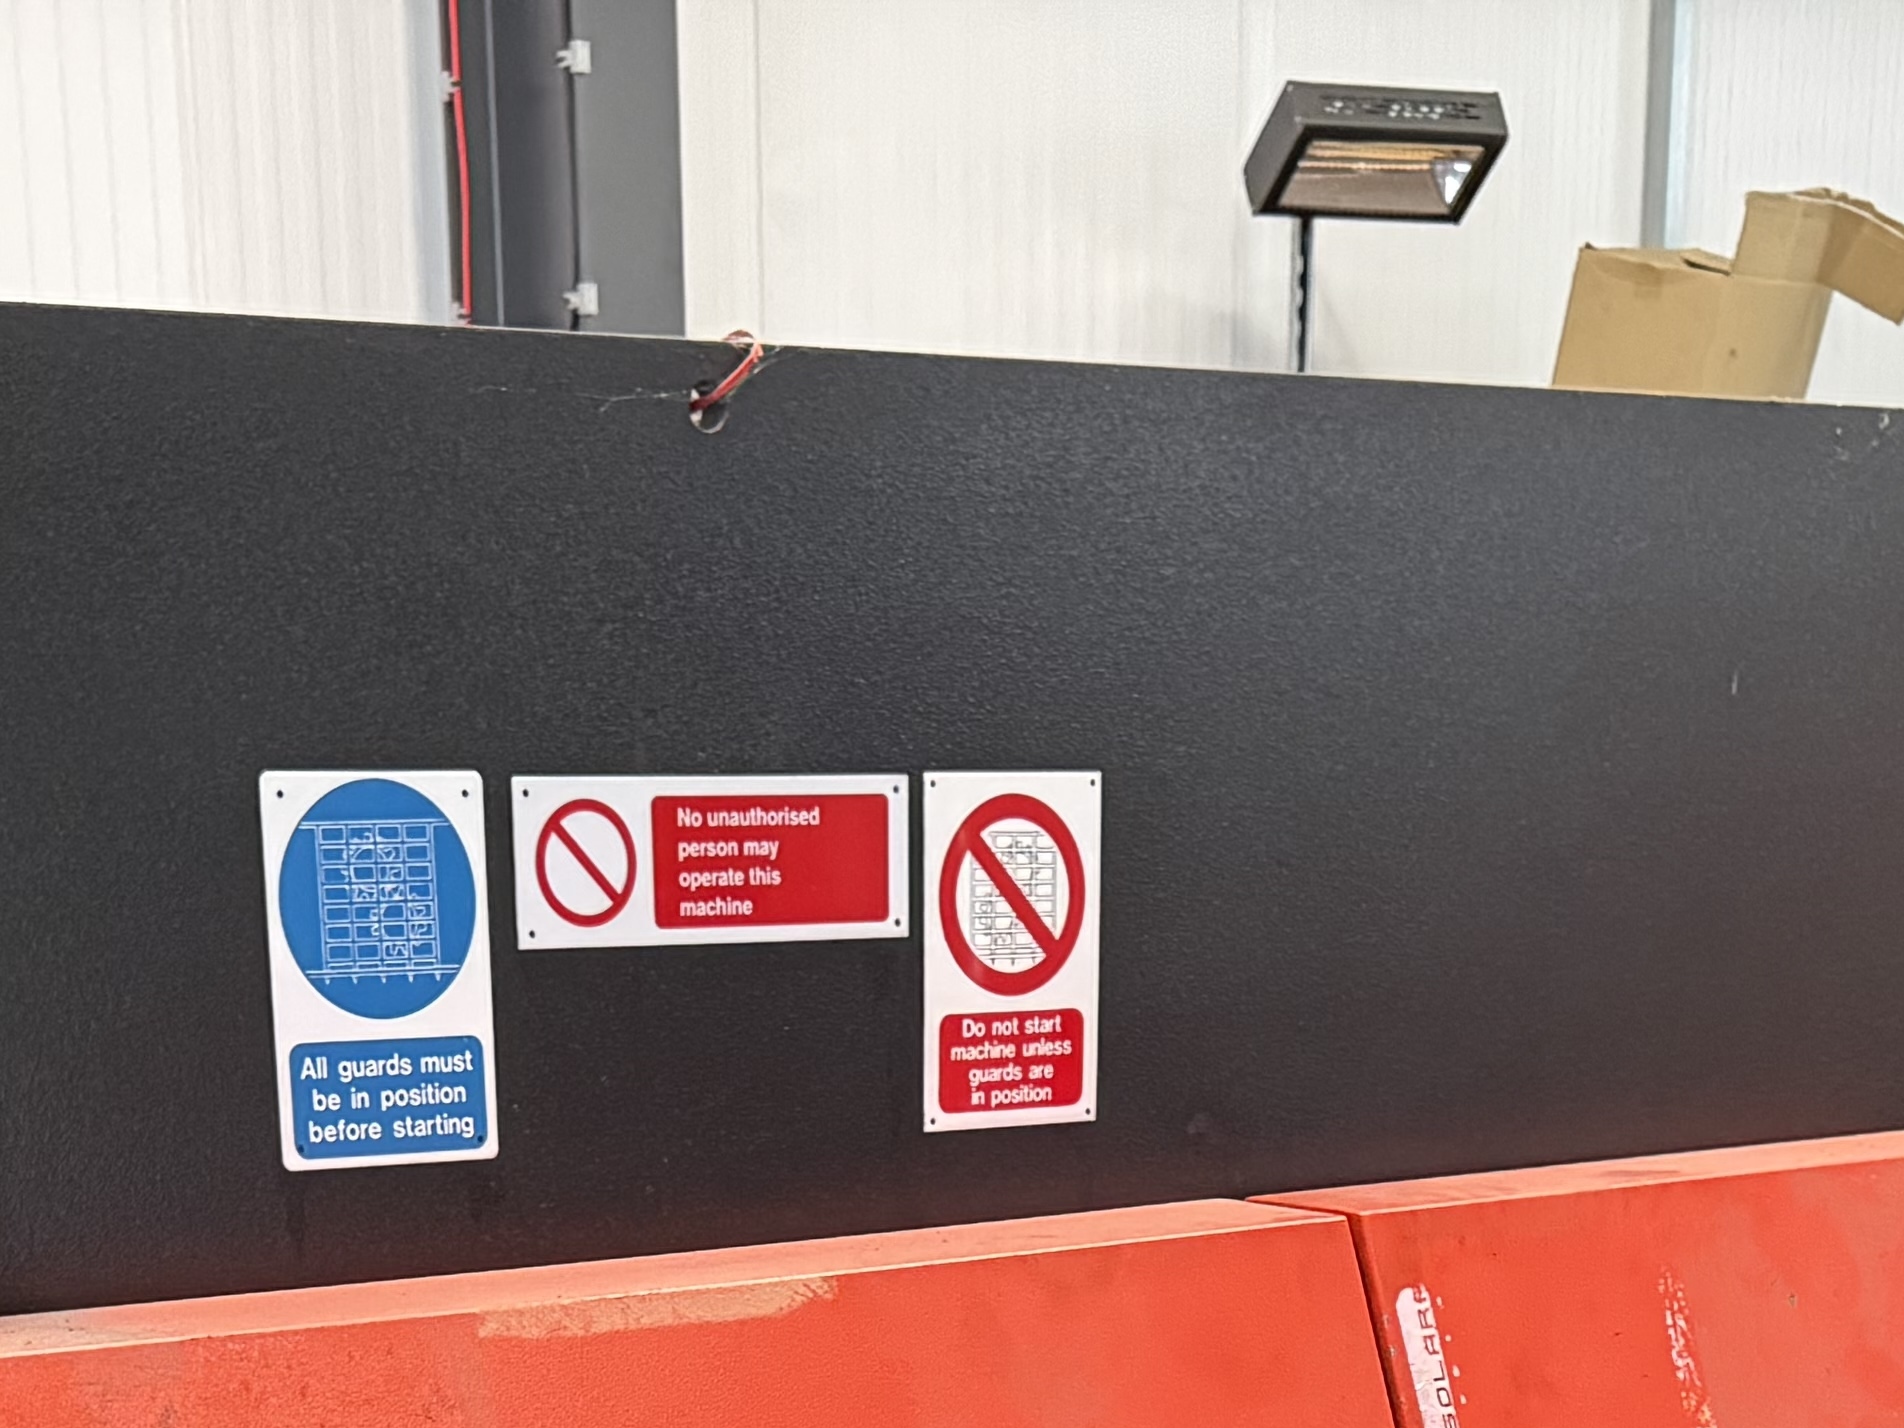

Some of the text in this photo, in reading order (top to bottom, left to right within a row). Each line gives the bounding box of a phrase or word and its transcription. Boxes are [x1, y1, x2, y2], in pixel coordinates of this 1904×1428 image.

[677, 807, 820, 827] No unauthorised
[678, 841, 779, 861] person may
[679, 867, 781, 891] operate this
[680, 897, 753, 916] machine
[962, 1015, 1061, 1038] Do not start
[950, 1037, 1072, 1061] machine unless
[300, 1050, 474, 1083] All guards must
[968, 1063, 1054, 1087] guards are
[312, 1082, 467, 1112] be in position
[971, 1085, 1052, 1108] in position
[308, 1113, 475, 1144] before starting
